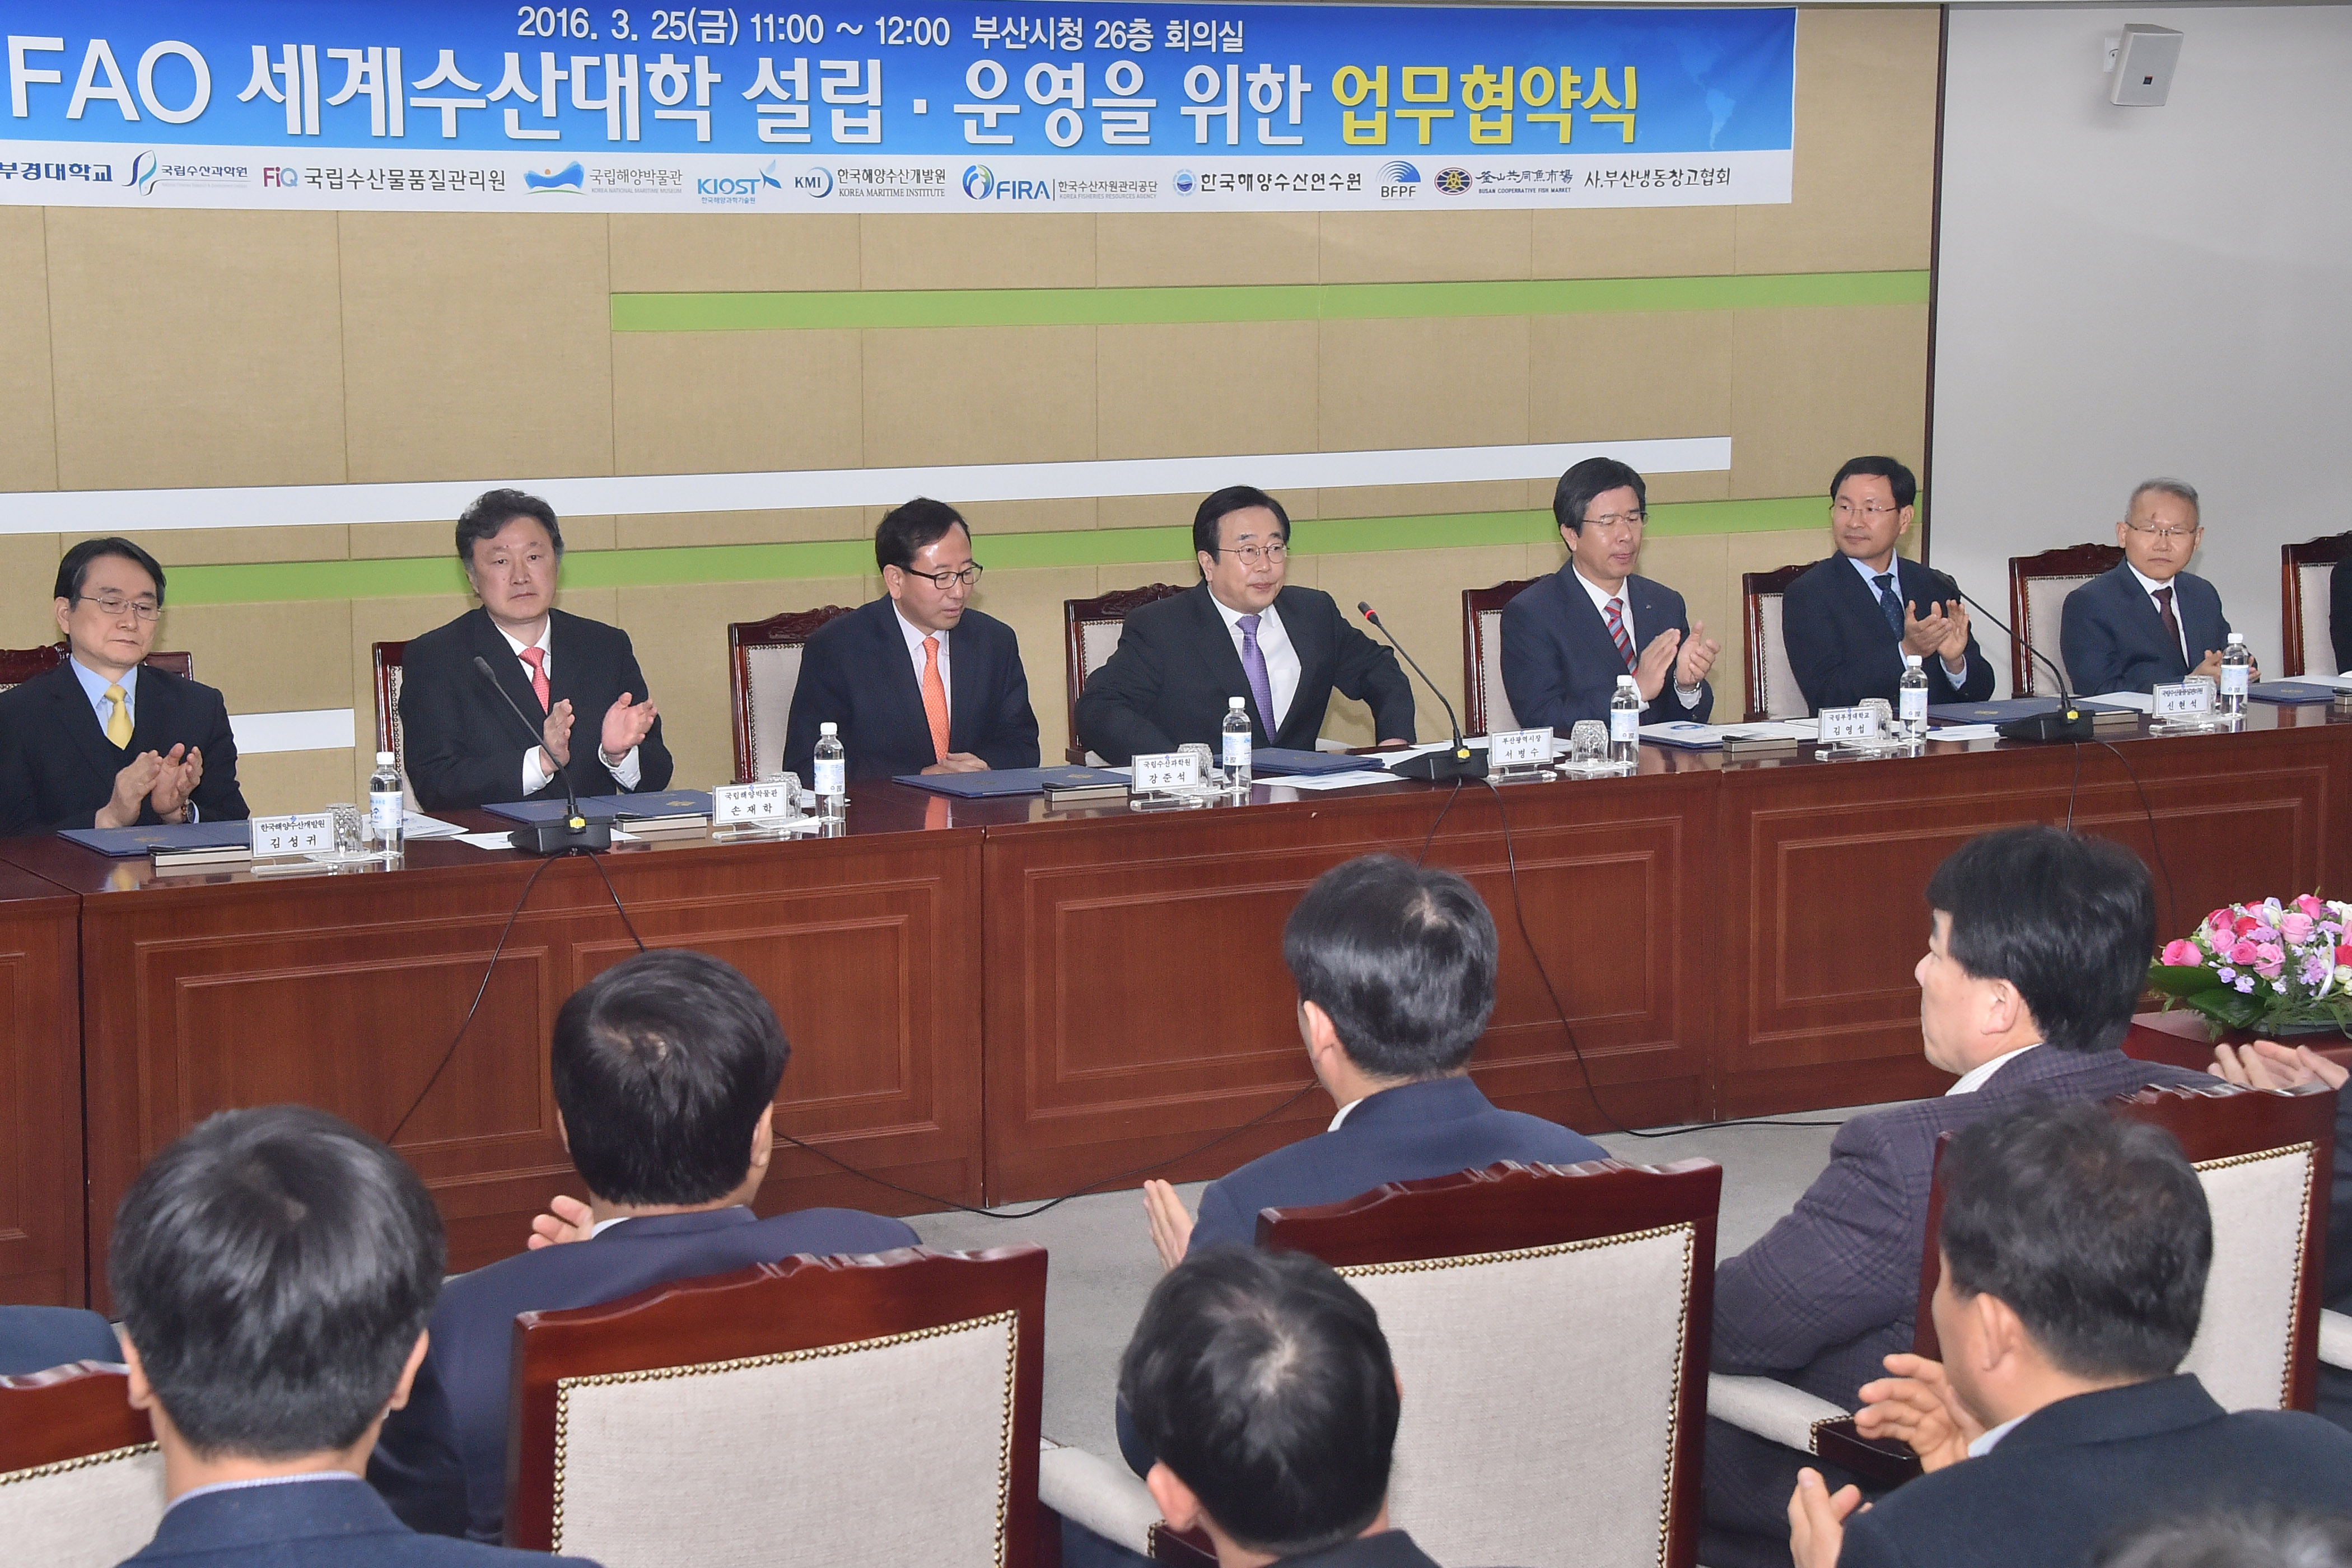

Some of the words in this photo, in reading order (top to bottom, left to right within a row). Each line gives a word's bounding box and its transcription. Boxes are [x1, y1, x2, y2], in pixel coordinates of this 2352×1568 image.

[517, 6, 598, 39] 2016.
[612, 10, 638, 41] 3.
[651, 7, 739, 45] 25(금)
[751, 14, 823, 44] 11:00
[875, 16, 950, 46] 12:00
[972, 17, 1084, 52] 부산시청
[1094, 18, 1154, 53] 26층
[1166, 20, 1244, 53] 회의실
[8, 35, 211, 124] FAO
[237, 44, 721, 142] 세계수산대학
[741, 57, 882, 143] 설립
[954, 59, 1157, 148] 운영을
[1180, 64, 1312, 146] 위한
[1332, 64, 1637, 145] 업무협약식
[0, 162, 113, 181] 부경대학교
[162, 165, 248, 177] 국립수산과학원
[590, 169, 682, 186] 국립해양박물관
[837, 169, 945, 184] 한국해양수산개발원
[1476, 170, 1573, 184] 釜山共同魚市場
[1584, 167, 1731, 188] 사.부산냉동창고협회
[304, 167, 505, 191] 국립수산물품질관리원
[698, 178, 761, 194] KIOST
[795, 176, 821, 188] KMI
[1201, 173, 1361, 192] 한국해양수산연수원
[839, 188, 864, 197] KOREA
[867, 188, 904, 197] MARITIME
[906, 188, 945, 197] INSTITUTE
[996, 180, 1051, 200] FIRA
[1058, 180, 1158, 193] 한국수산자원관리공단
[1381, 186, 1416, 198] BFPF
[1829, 712, 1869, 721] 국립부경대학교
[1502, 735, 1541, 744] 부산광역시장
[1144, 758, 1190, 768] 국립수산과학원
[725, 789, 777, 800] 국립해양박물관
[261, 819, 325, 832] 한국해양수산개발원
